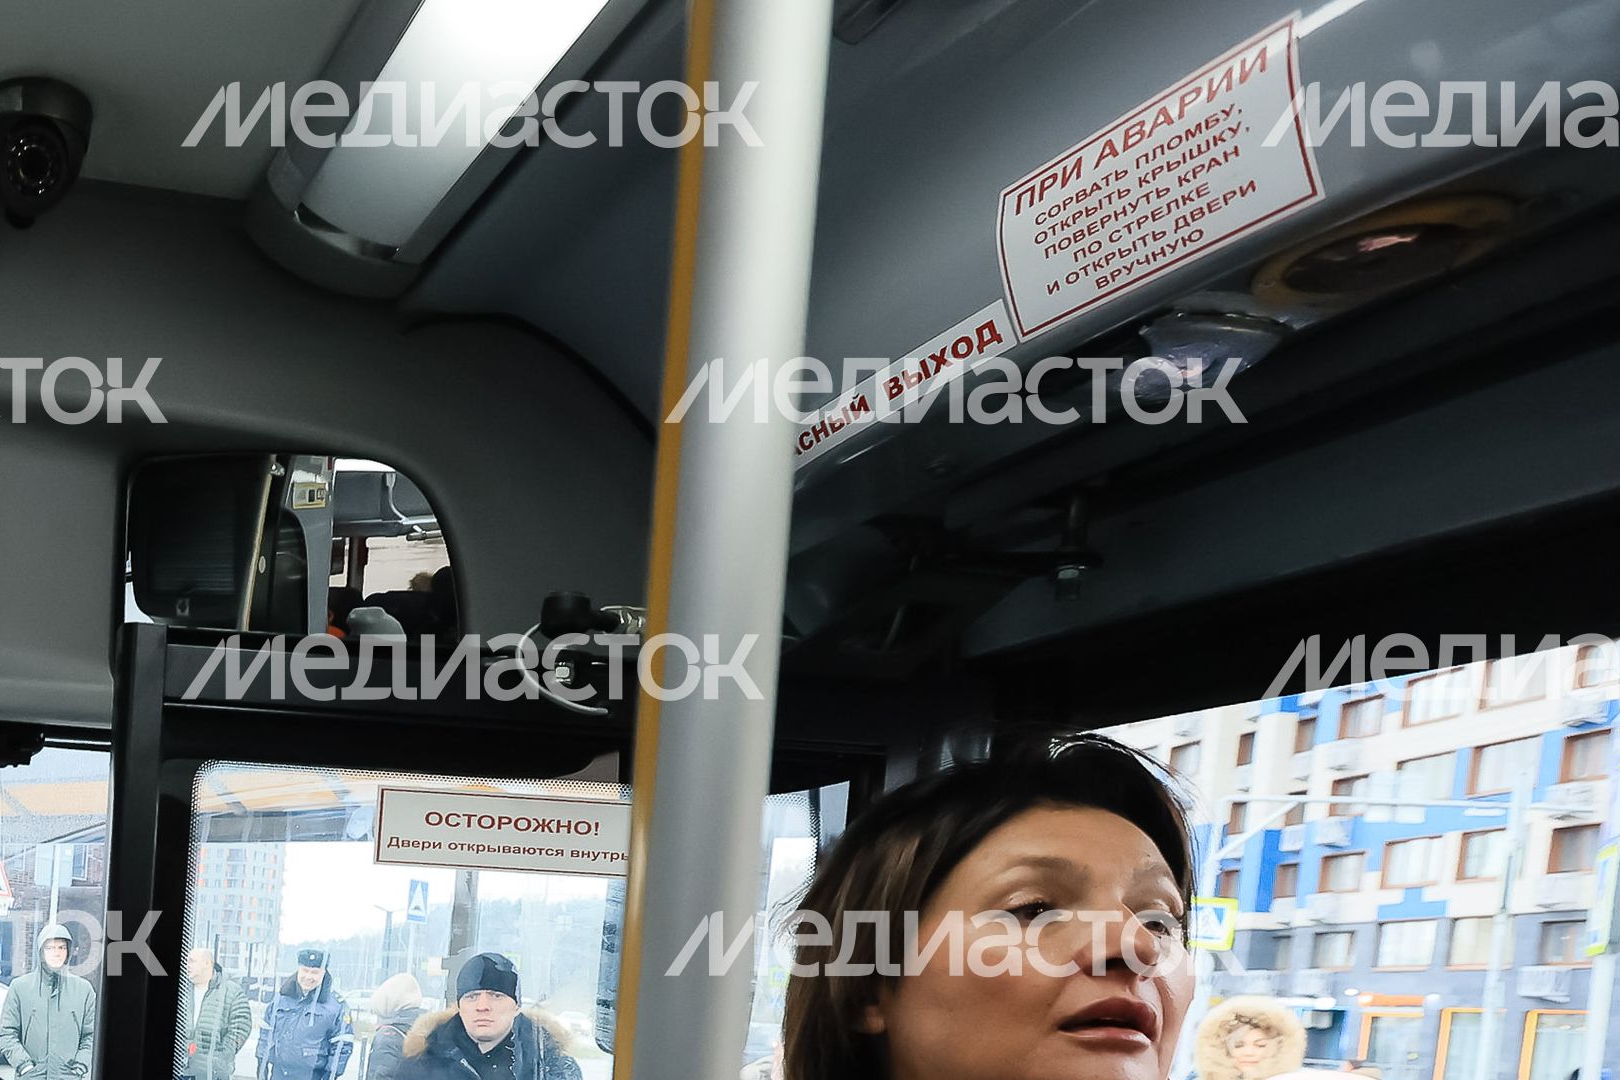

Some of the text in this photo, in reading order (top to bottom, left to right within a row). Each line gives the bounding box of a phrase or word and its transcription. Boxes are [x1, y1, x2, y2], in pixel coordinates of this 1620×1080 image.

[1014, 46, 1268, 215] ПРИ АВАРИИ
[1033, 103, 1244, 226] СОРВАТЬ ПЛОМБУ,
[1033, 121, 1251, 245] ОТКРЫТЬ КРЫШКУ,
[1044, 145, 1240, 260] ПОВЕРНУТЬ КРАН
[1046, 179, 1258, 297] И ОТКРЫТЬ ДВЕРИ
[1072, 182, 1212, 264] ПО СТРЕЛКЕ
[1094, 228, 1206, 291] ВРУЧНУЮ
[795, 319, 1004, 456] СНЫЙ ВЫХОД
[387, 836, 442, 851] Двери
[448, 840, 564, 858] открываются
[424, 811, 600, 836] ОСТОРОЖНО!
